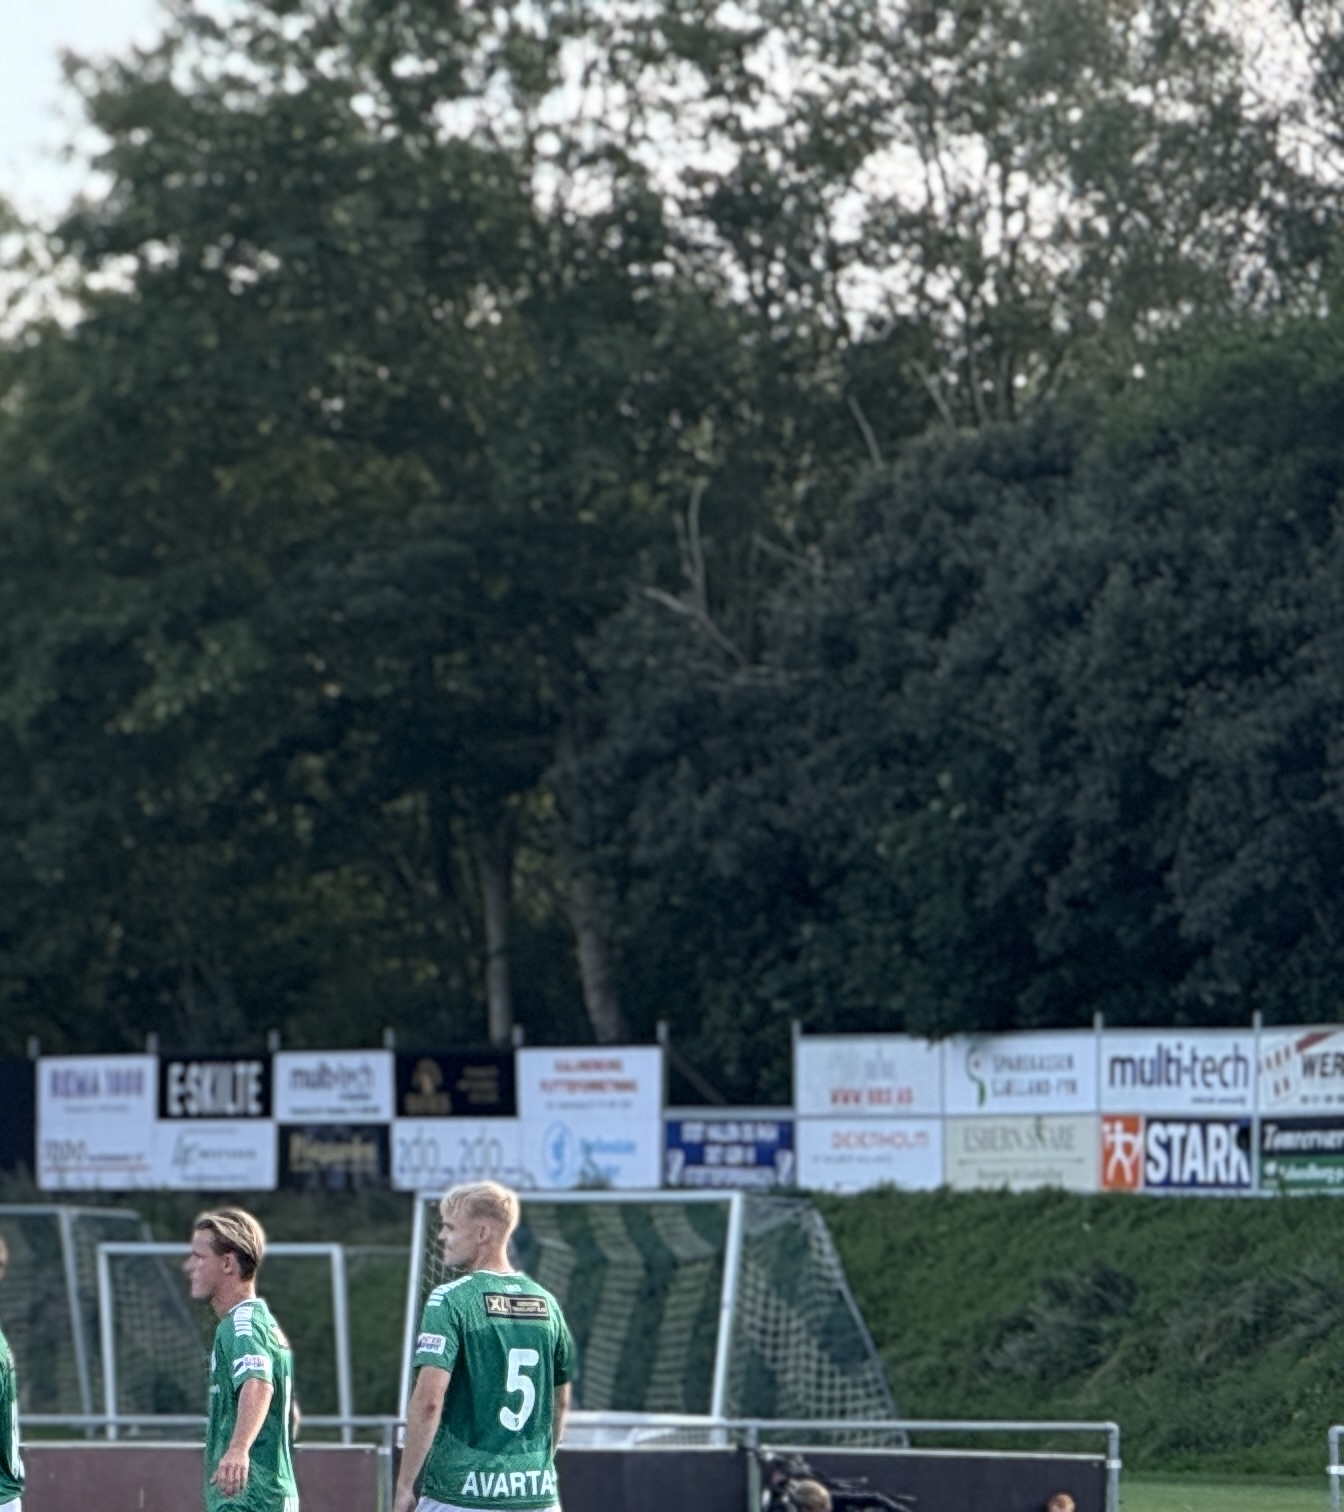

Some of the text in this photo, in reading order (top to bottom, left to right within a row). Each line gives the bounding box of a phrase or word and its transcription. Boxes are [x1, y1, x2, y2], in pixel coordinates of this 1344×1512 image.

[1109, 1043, 1249, 1088] multi-tech
[1146, 1122, 1250, 1185] STARK
[499, 1348, 540, 1432] 5
[461, 1469, 556, 1498] AVARTA
